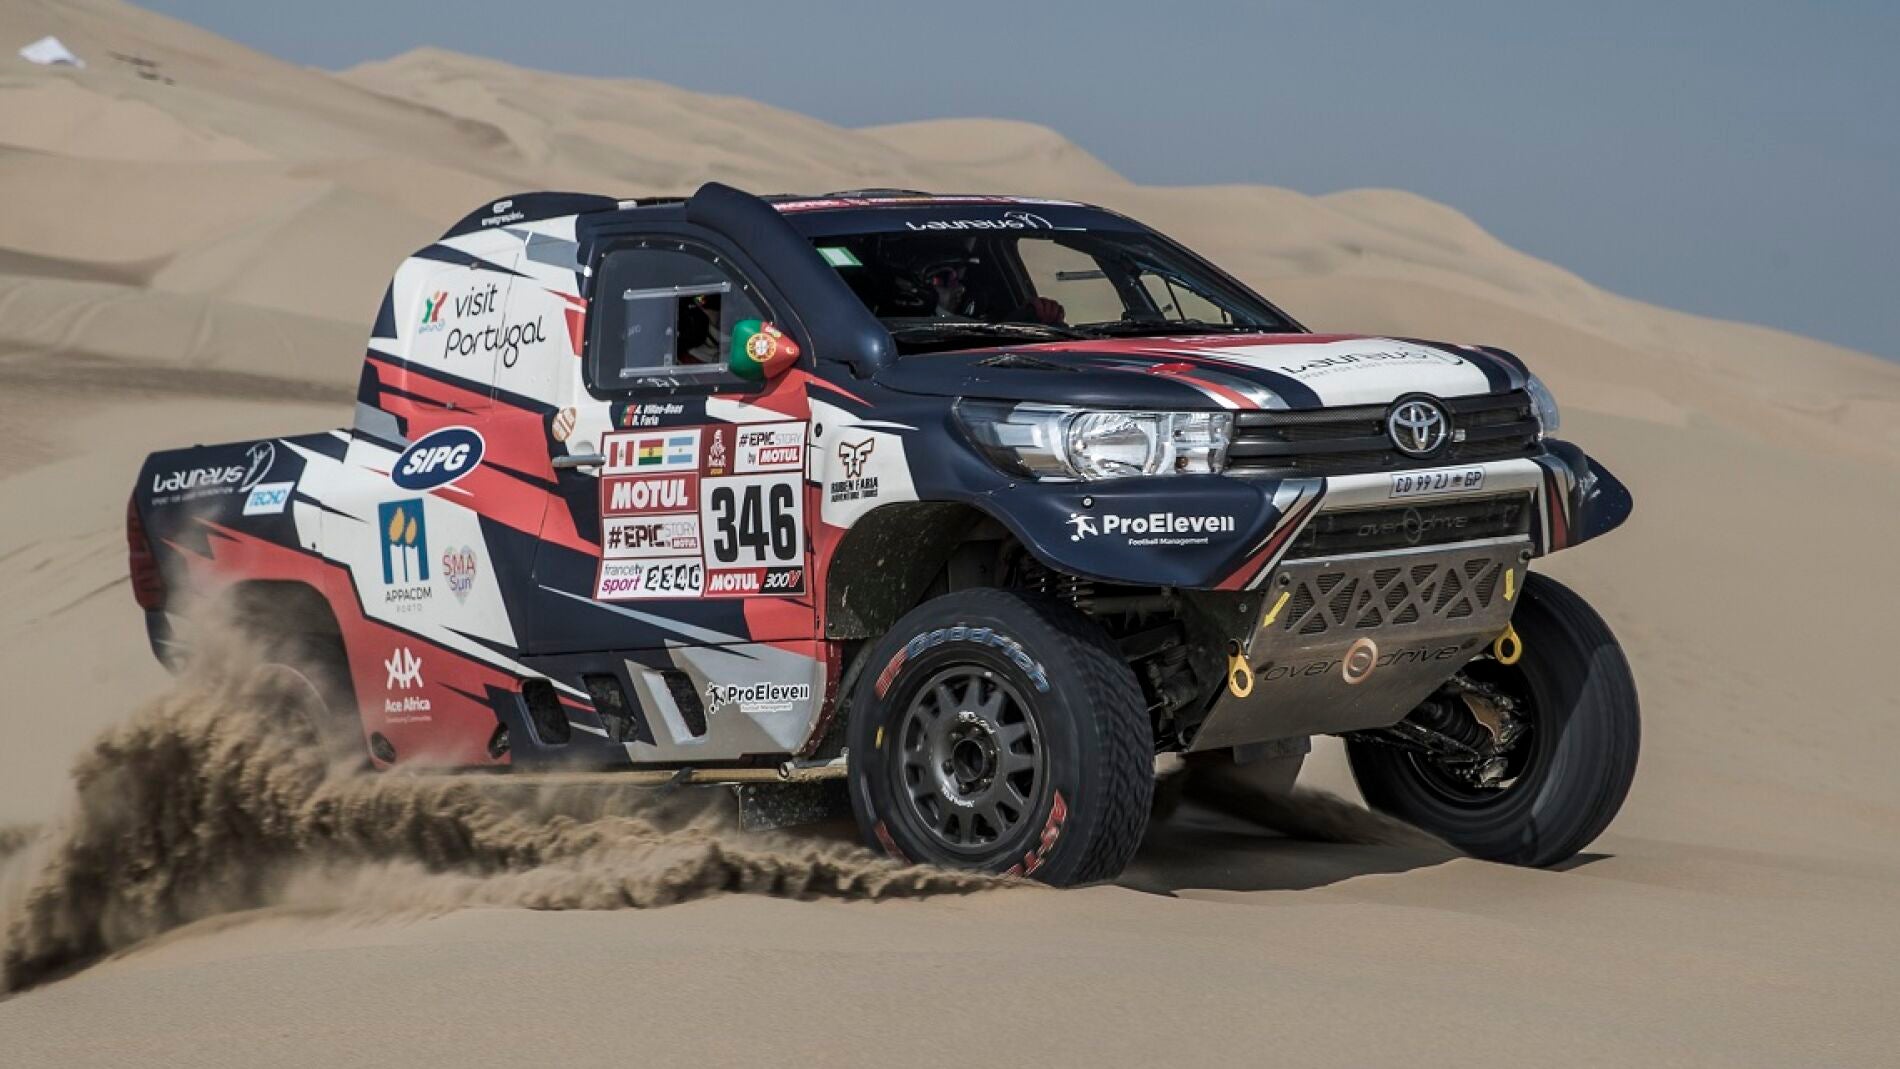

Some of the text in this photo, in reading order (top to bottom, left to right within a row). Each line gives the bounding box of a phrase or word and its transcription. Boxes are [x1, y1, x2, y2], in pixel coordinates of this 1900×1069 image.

[455, 283, 498, 319] visit
[444, 315, 546, 368] Portugal
[402, 443, 470, 475] SIPG
[760, 447, 798, 463] MOTUL
[611, 480, 688, 510] MOTUL
[1396, 476, 1411, 492] CD
[711, 483, 797, 563] 346
[1128, 537, 1208, 546] Football Management
[443, 553, 476, 576] SMA
[602, 575, 640, 594] sport
[709, 570, 801, 592] MOTUL 300V
[1264, 645, 1459, 681] over drive
